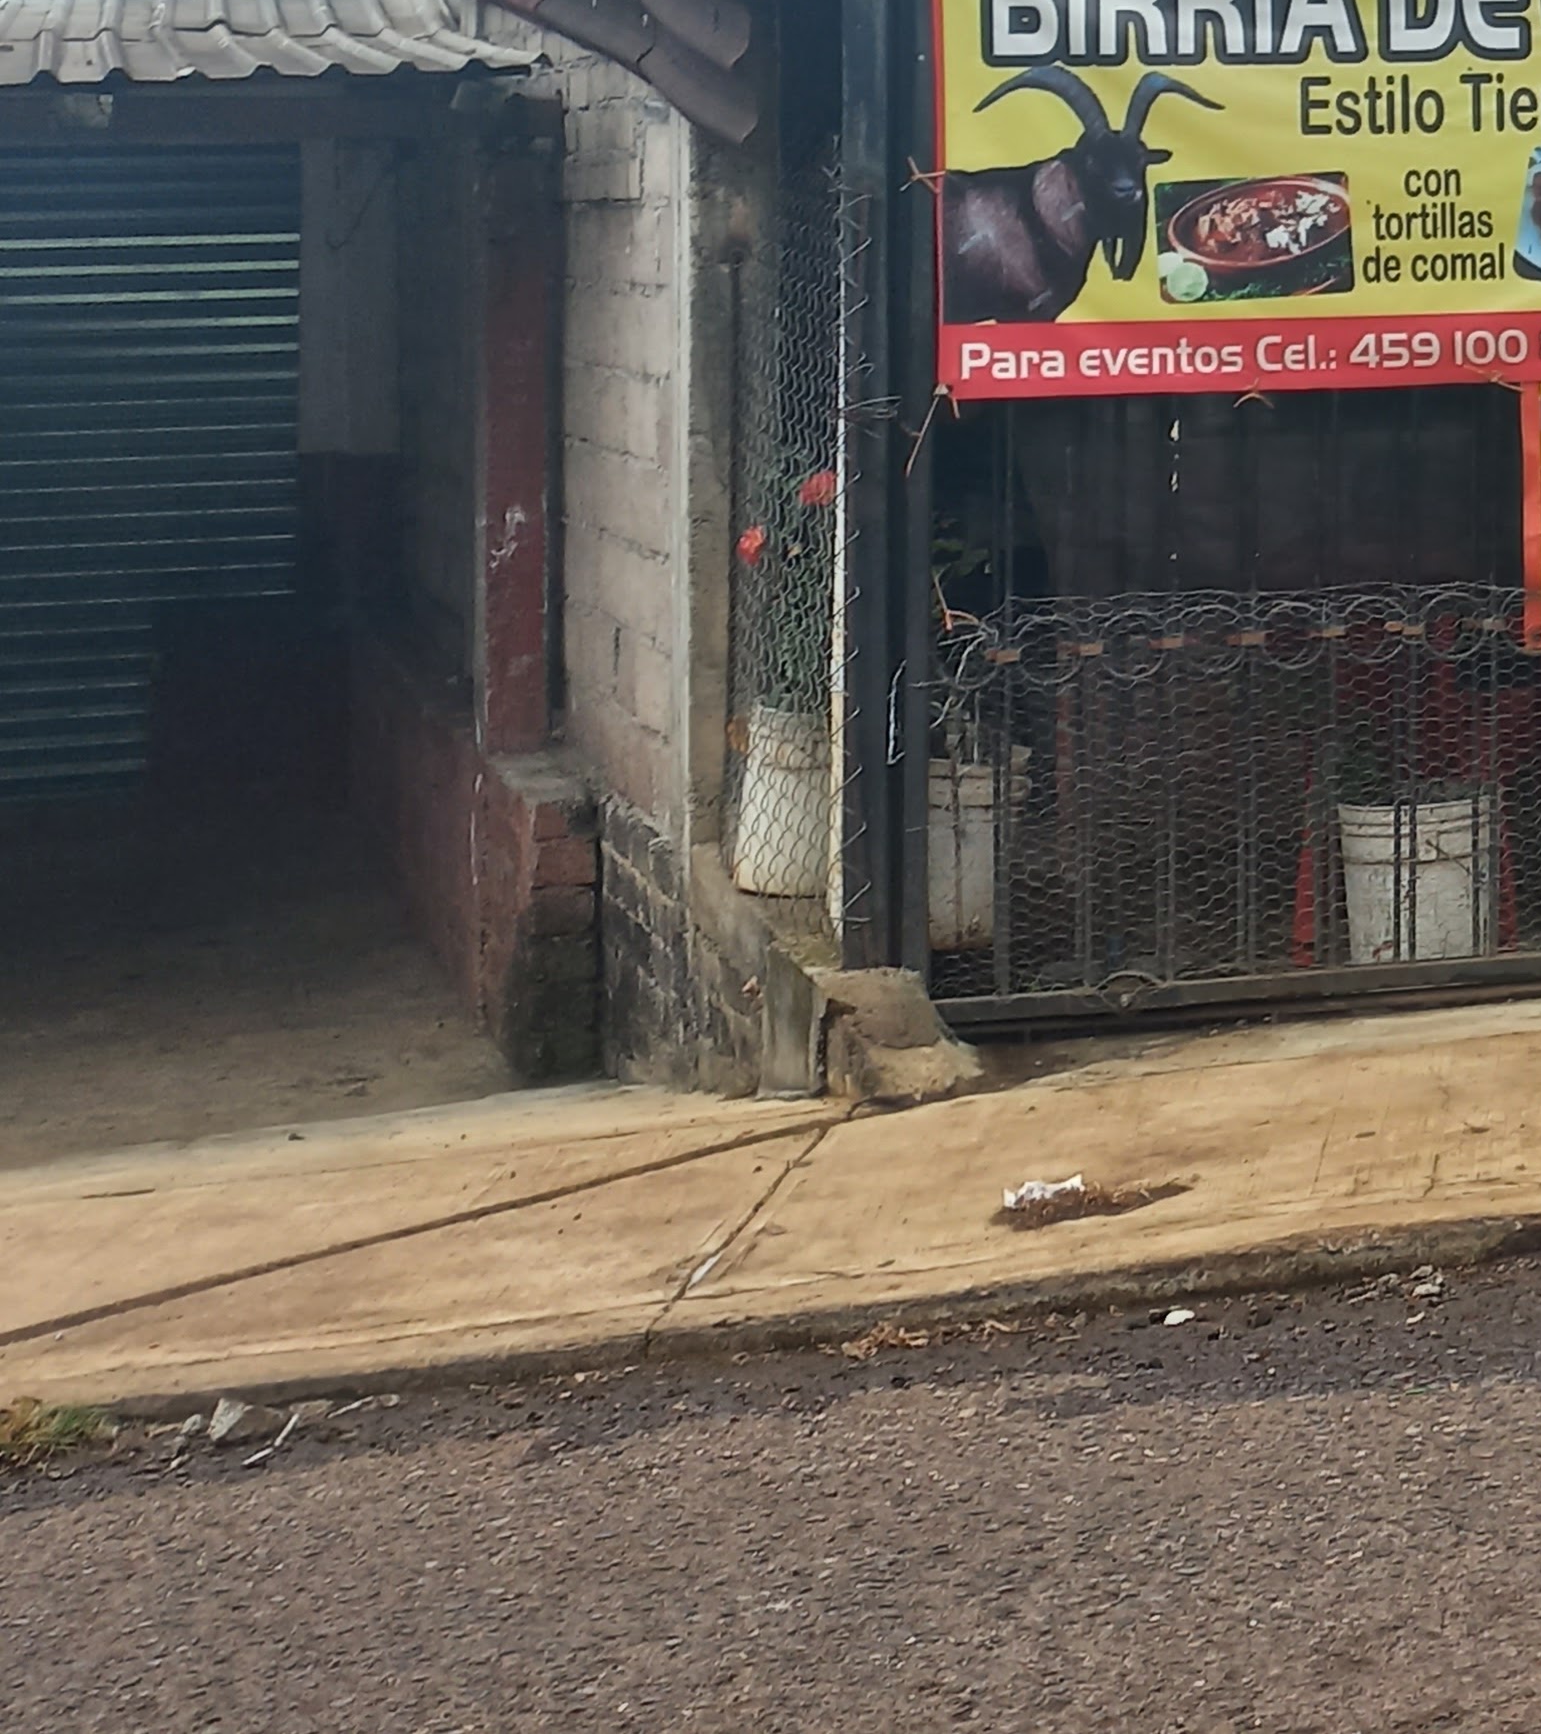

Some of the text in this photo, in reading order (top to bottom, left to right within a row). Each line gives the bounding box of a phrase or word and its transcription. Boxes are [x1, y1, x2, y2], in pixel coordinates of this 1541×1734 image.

[1300, 74, 1445, 135] Estilo
[1404, 168, 1461, 197] con
[1372, 202, 1494, 240] tortillas
[1362, 242, 1505, 283] de comal
[961, 342, 1065, 380] Para
[1079, 337, 1243, 376] eventos
[1256, 335, 1337, 371] Cel.:
[1349, 332, 1440, 368] 459
[1454, 329, 1528, 366] 100
